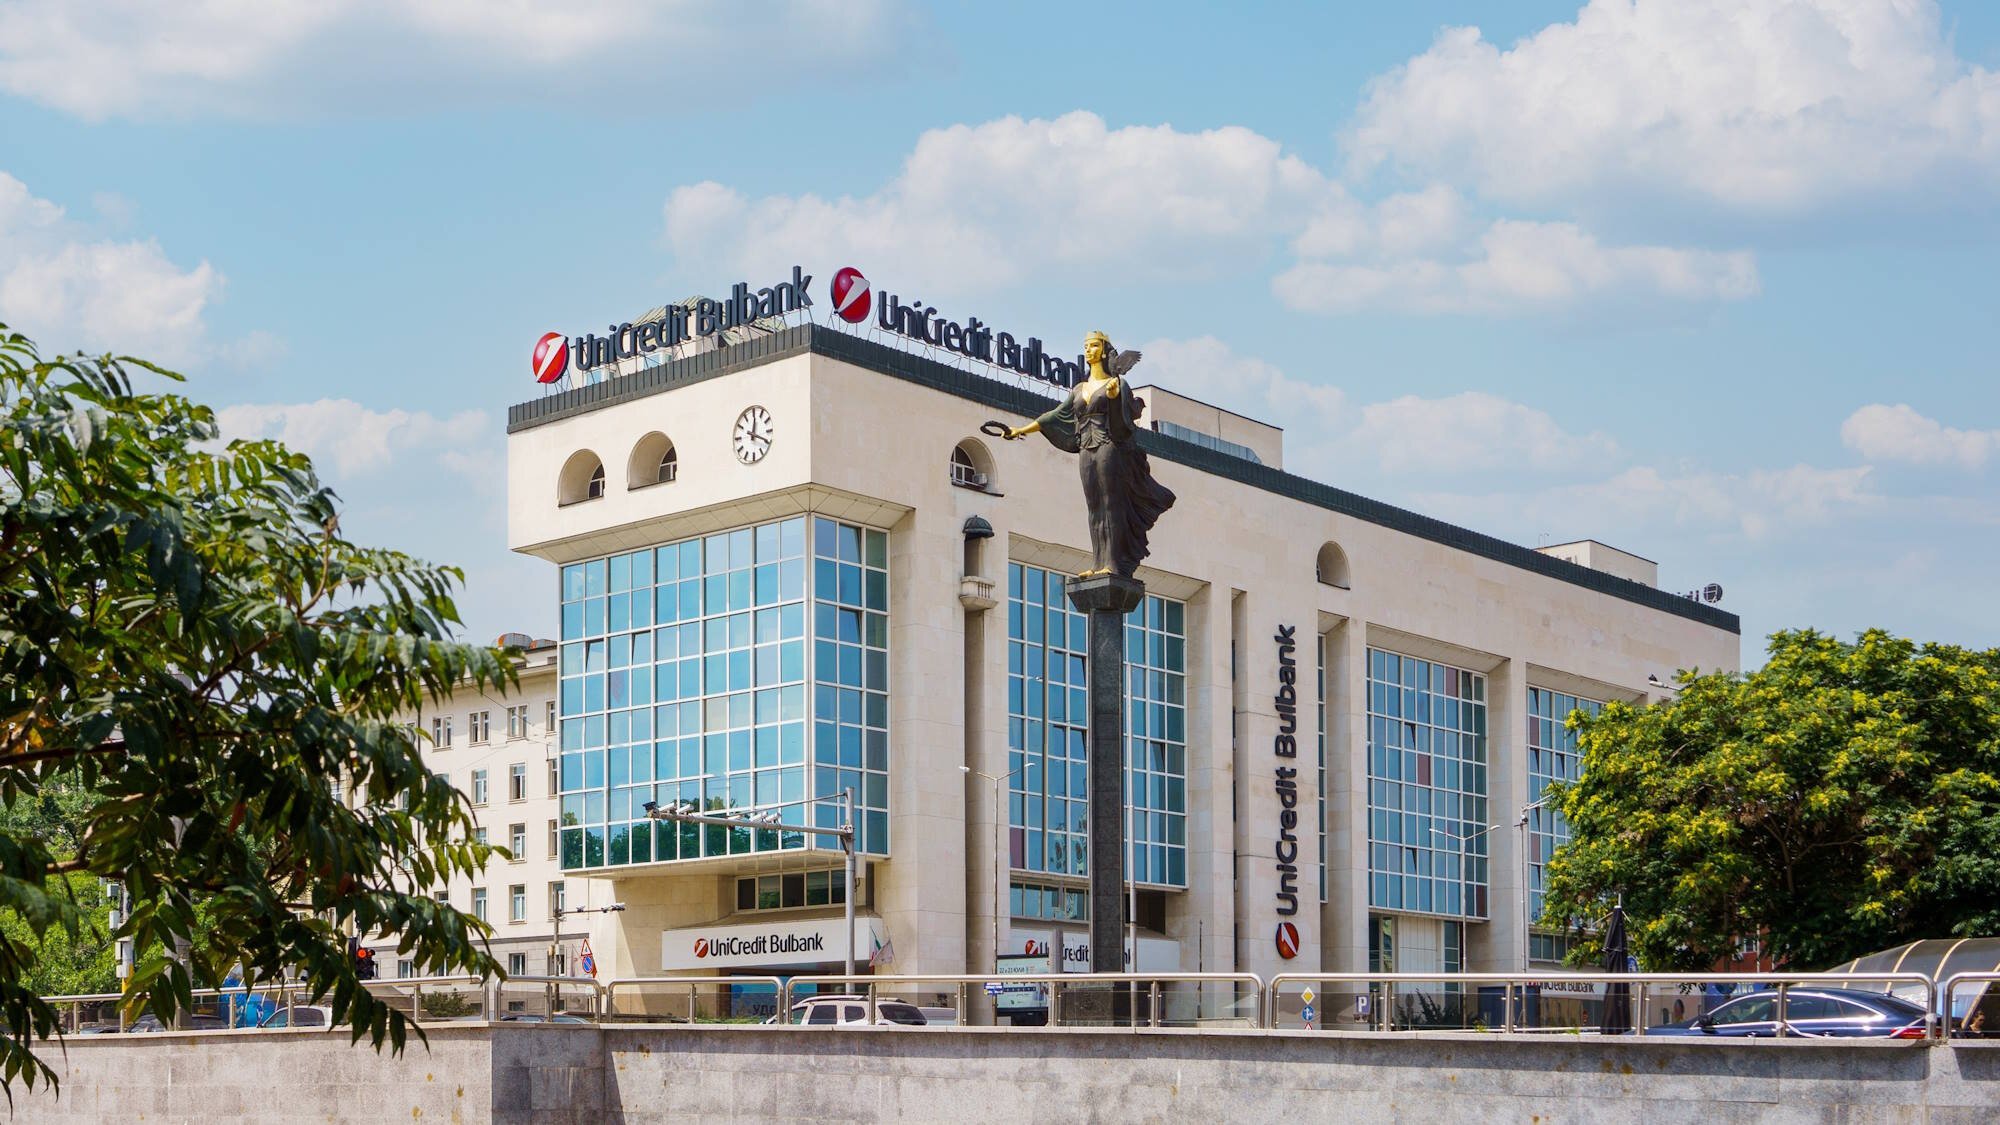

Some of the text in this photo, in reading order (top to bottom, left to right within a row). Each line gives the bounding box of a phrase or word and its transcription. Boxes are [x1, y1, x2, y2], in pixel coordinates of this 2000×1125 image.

[576, 265, 814, 371] UniCredit Bulbank
[878, 290, 992, 363] UniCredit
[1274, 624, 1298, 916] UniCredit Bulbank
[710, 932, 824, 957] UniCredit Bulbank
[1039, 941, 1089, 962] Uredit
[1358, 996, 1367, 1013] P
